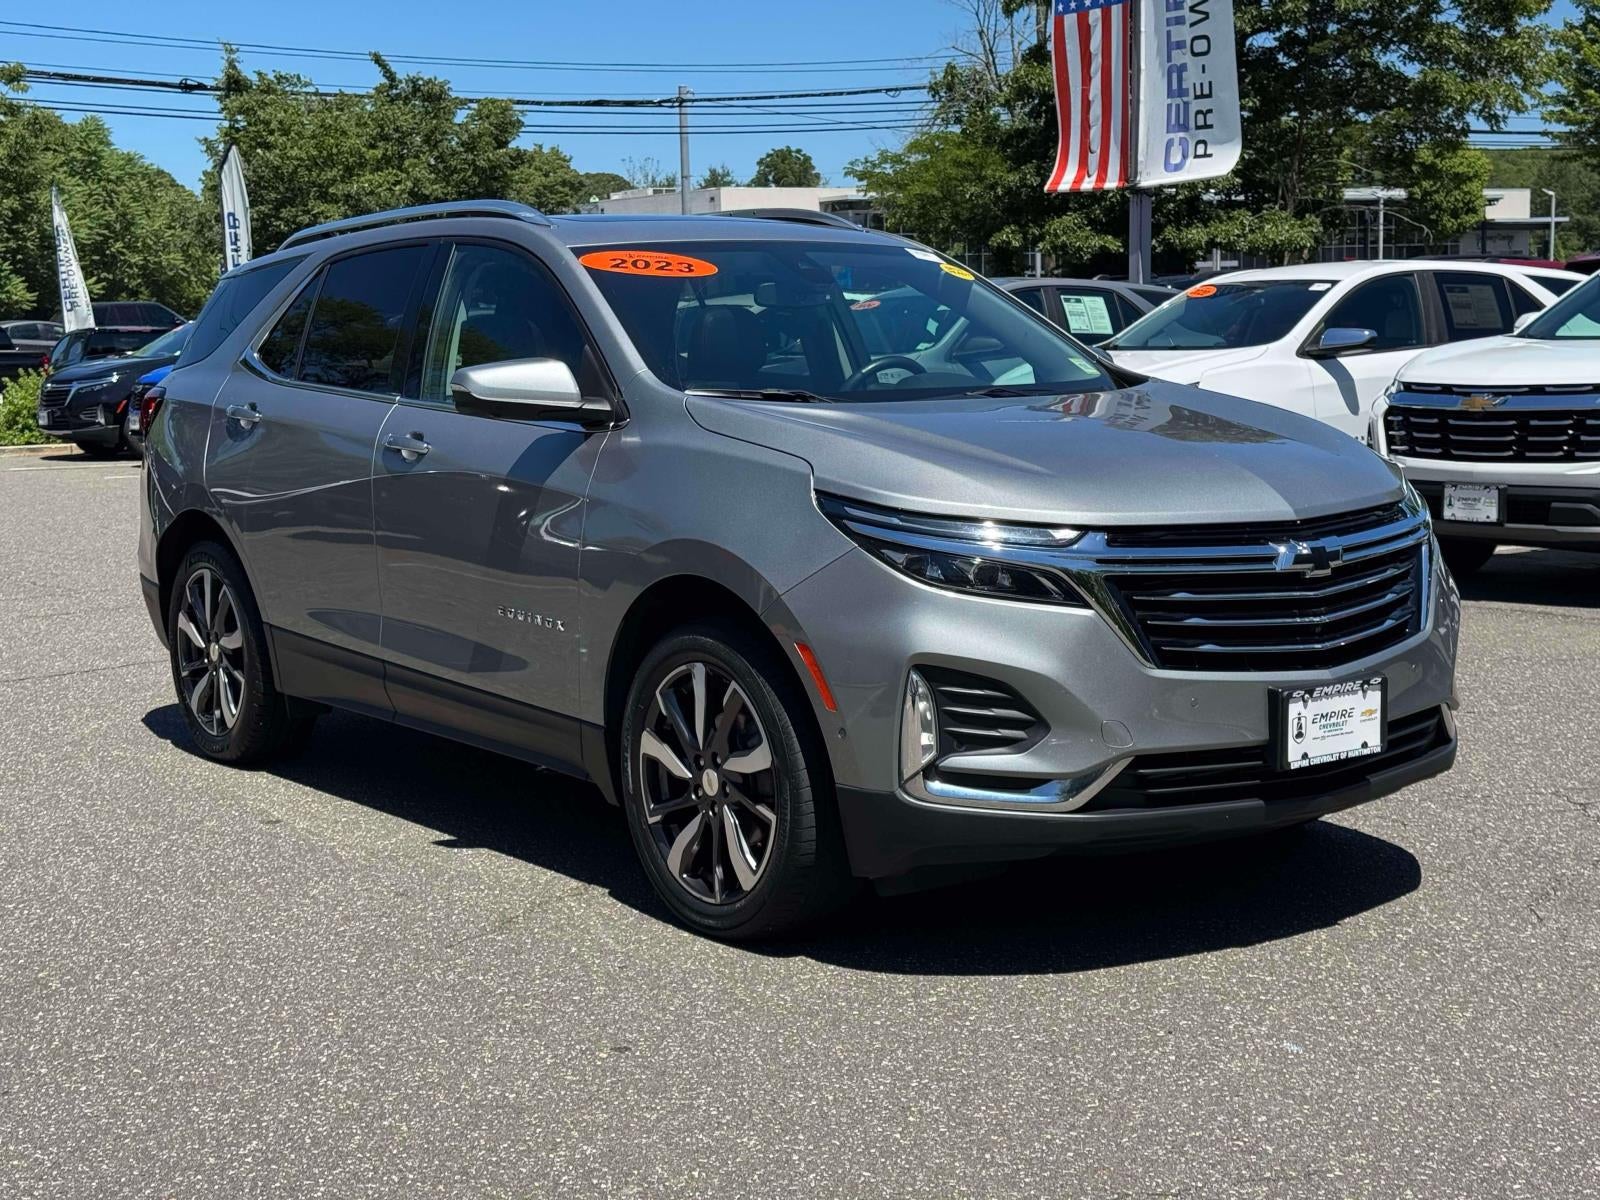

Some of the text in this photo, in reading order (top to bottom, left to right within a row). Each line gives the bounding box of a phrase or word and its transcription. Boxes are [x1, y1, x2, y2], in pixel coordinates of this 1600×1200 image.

[608, 257, 695, 273] 2023
[497, 605, 565, 631] EQUINOX
[1312, 680, 1363, 698] EMPIRE
[1312, 707, 1355, 724] EMPIRE
[1319, 720, 1348, 730] CHEVROLET
[1290, 745, 1381, 770] EMPIRE CHEVROLET OF HUNTINGTON
